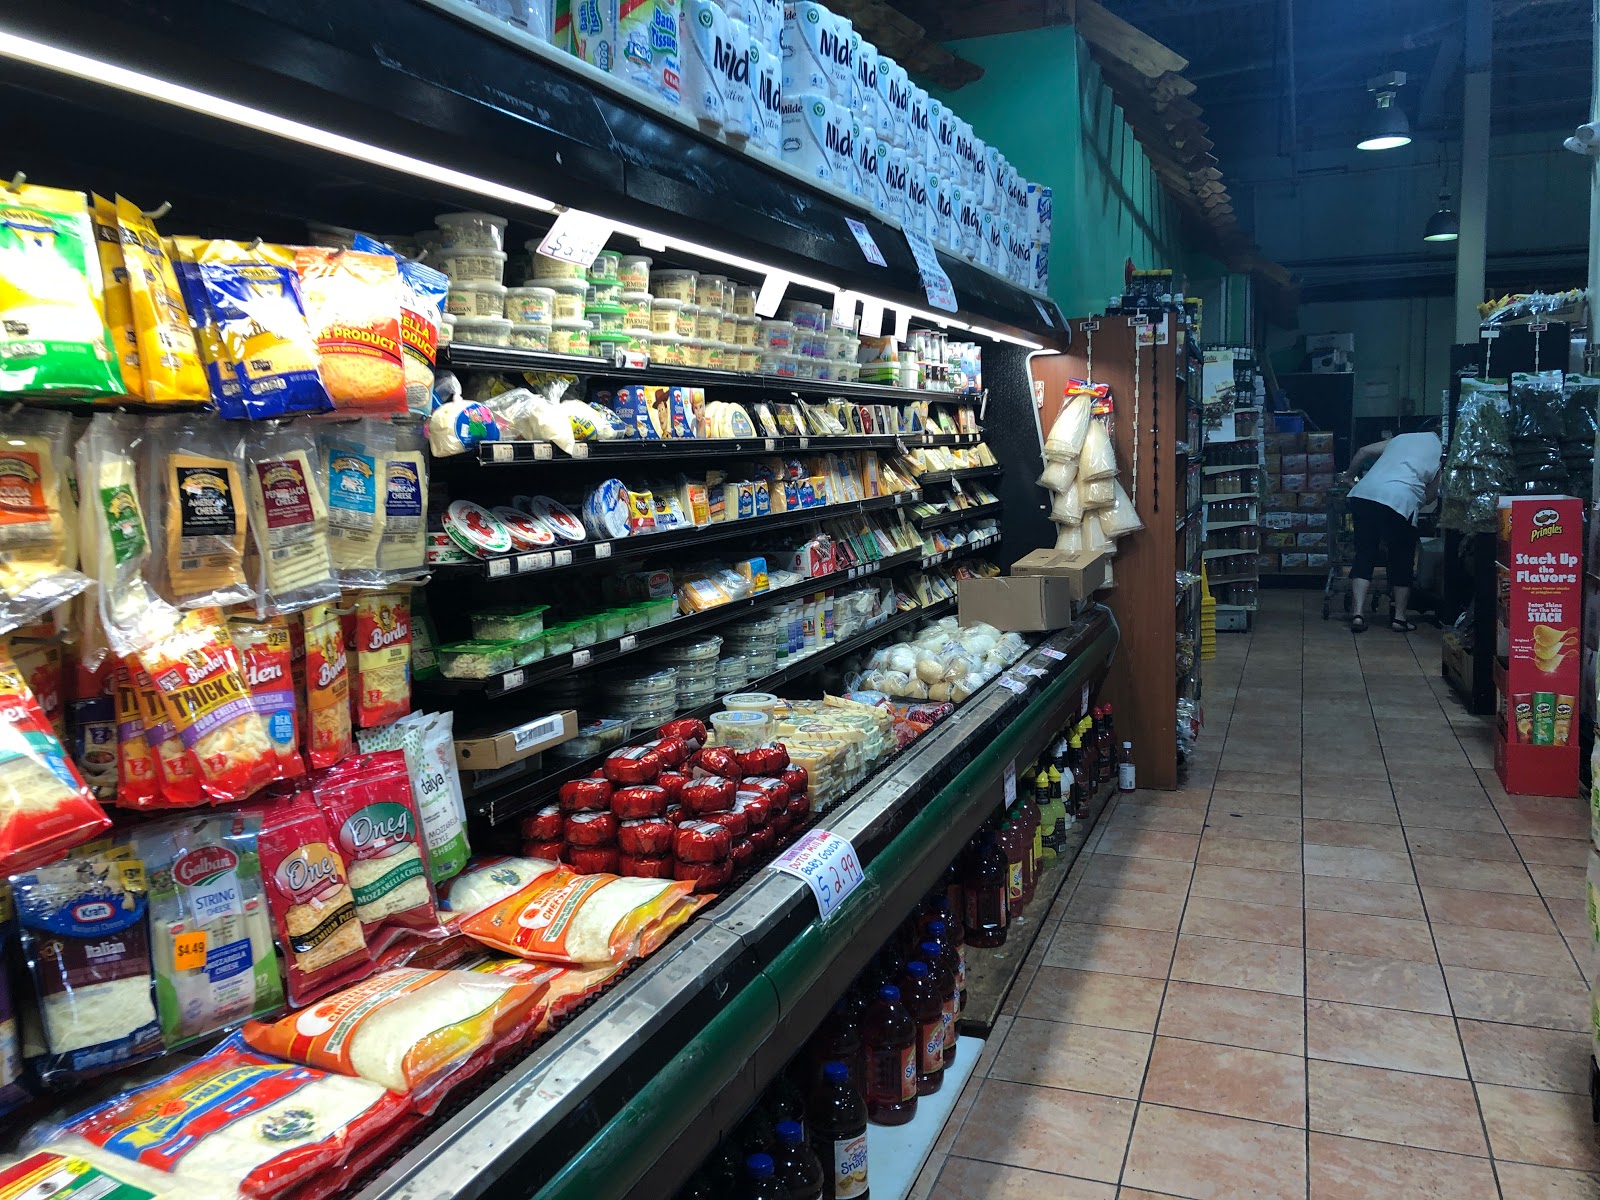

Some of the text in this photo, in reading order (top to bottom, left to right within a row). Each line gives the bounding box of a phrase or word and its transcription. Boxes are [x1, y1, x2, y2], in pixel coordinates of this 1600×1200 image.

[655, 8, 675, 32] Bath
[651, 27, 676, 51] Tissue
[334, 327, 397, 351] PRODUCT
[188, 498, 228, 508] AMERICAN
[275, 496, 299, 507] CHEESE
[392, 492, 412, 500] CHEESE
[195, 507, 223, 515] CHEESE
[1530, 524, 1563, 543] Pringles
[796, 554, 801, 566] 6
[1515, 552, 1578, 568] Stack Up
[1516, 570, 1577, 583] Flavors
[1539, 565, 1555, 574] the
[1528, 613, 1562, 622] STACK
[411, 628, 423, 638] ETA
[246, 664, 282, 686] den
[168, 678, 229, 718] THICK
[274, 714, 291, 725] REAL
[421, 773, 445, 795] daiya
[352, 810, 409, 847] Oneg
[430, 833, 449, 847] STYLE
[432, 839, 458, 857] SHREDS
[818, 840, 843, 860] GOUDA
[180, 854, 231, 880] Galbani
[829, 853, 858, 894] 2.99
[357, 866, 424, 904] MOZZARELLA CHEESE
[196, 888, 236, 910] STRING
[81, 905, 108, 918] Kraft
[206, 903, 232, 917] CHEESE
[84, 941, 126, 959] Italian
[177, 941, 205, 957] $4.49
[215, 963, 239, 975] CHEESE
[256, 974, 269, 986] 12
